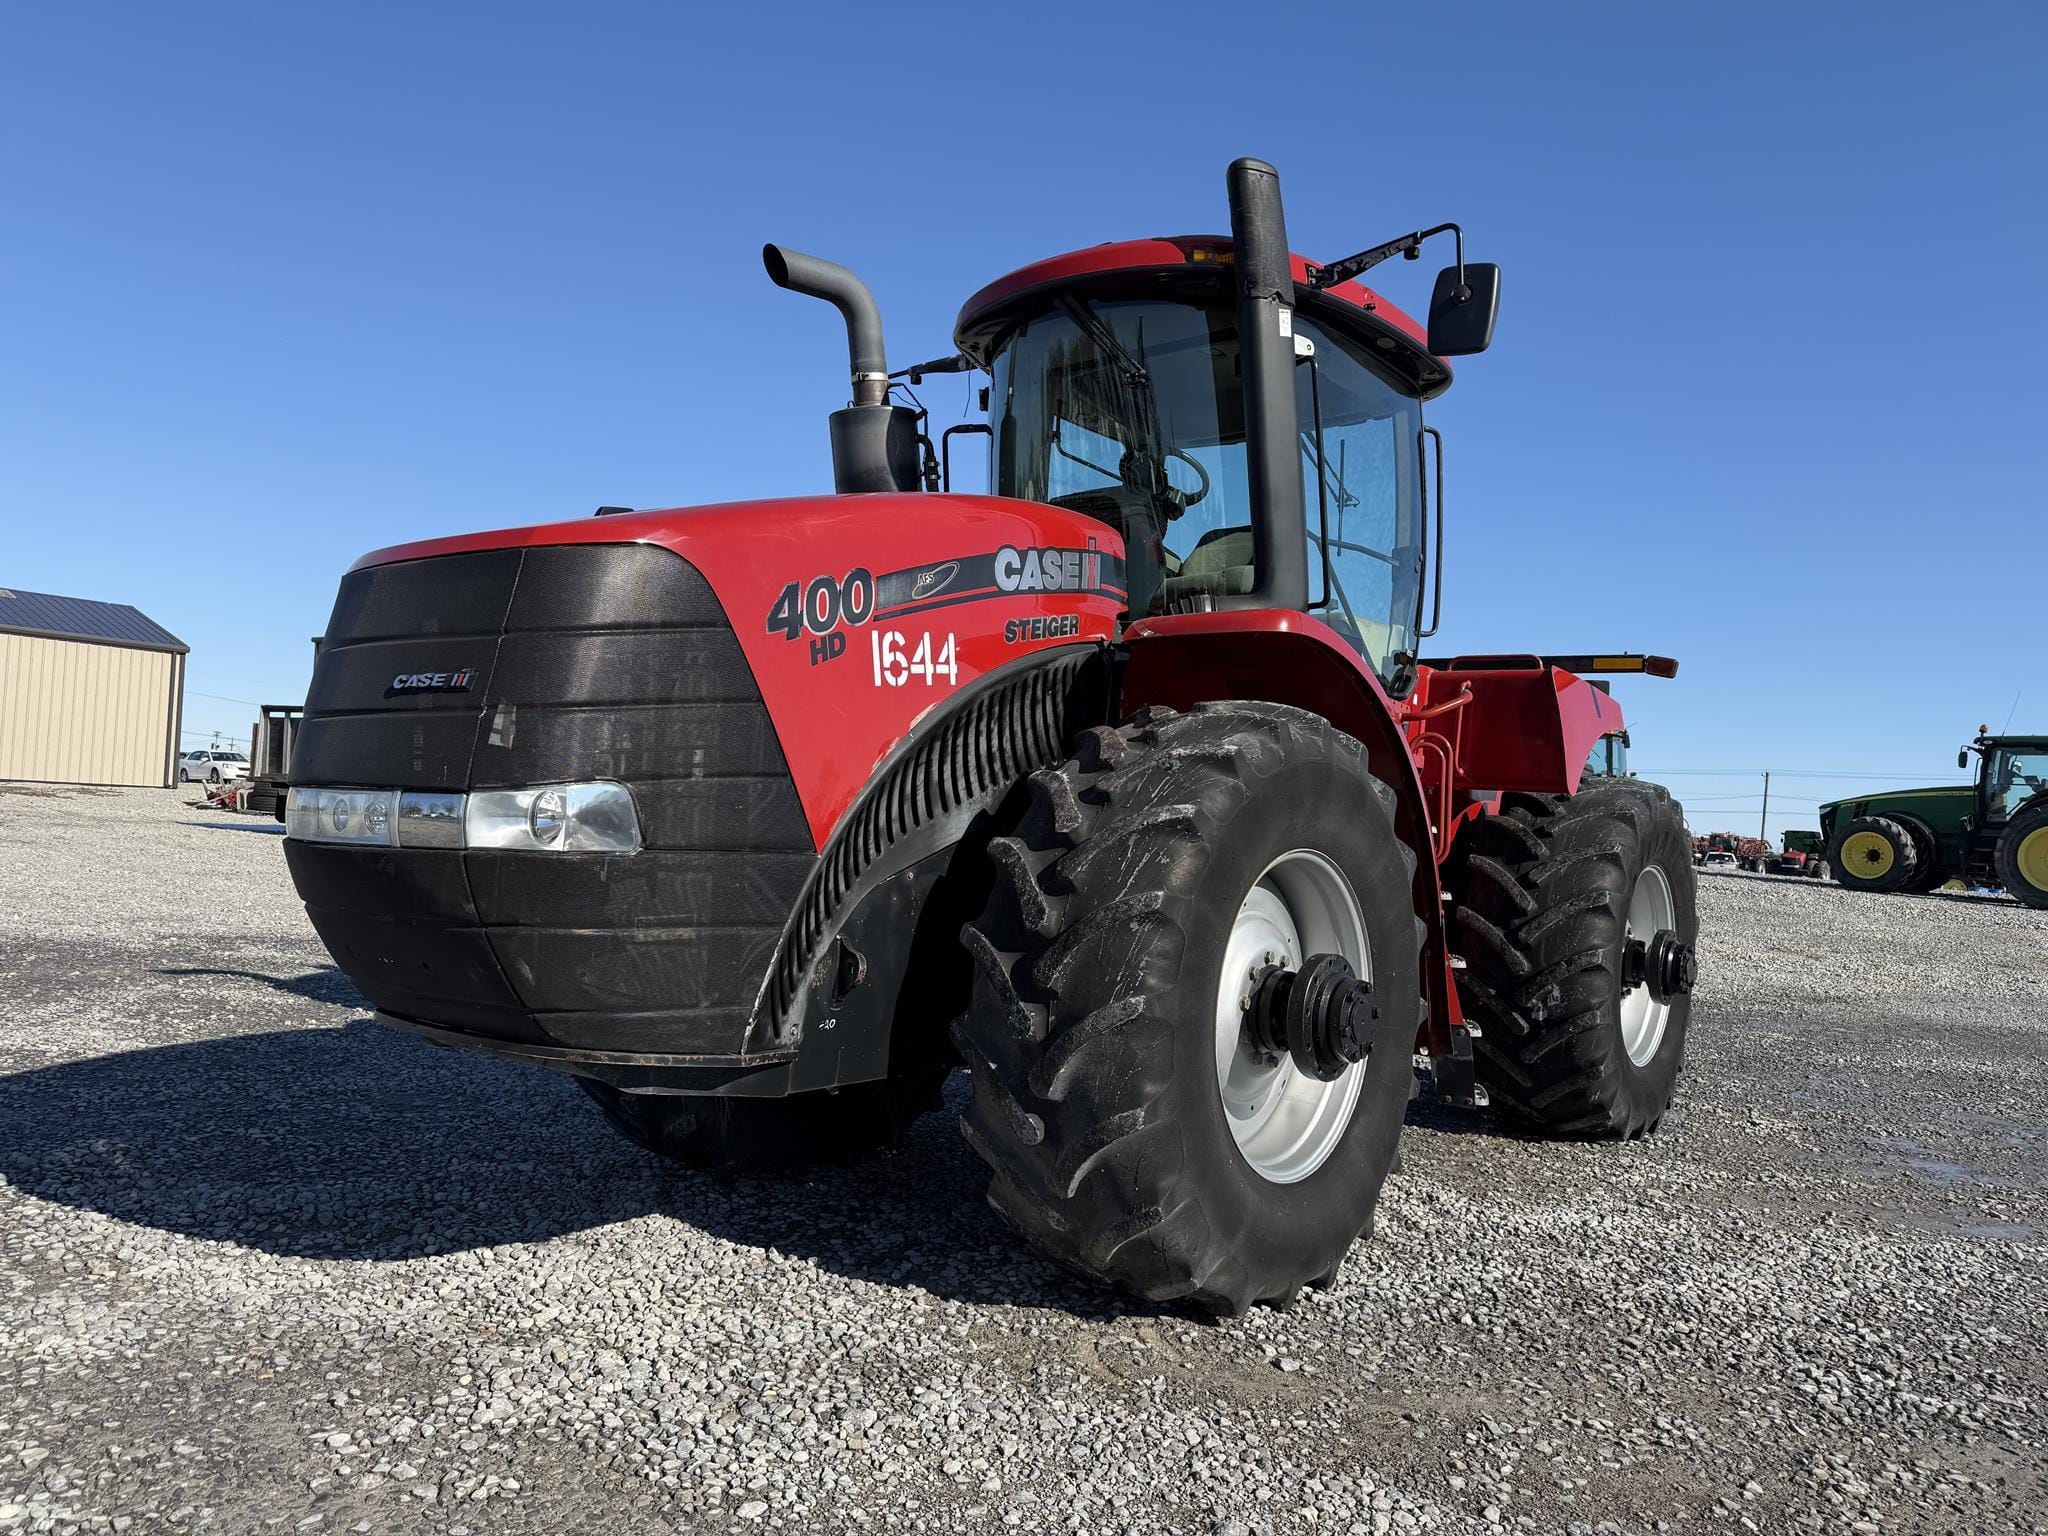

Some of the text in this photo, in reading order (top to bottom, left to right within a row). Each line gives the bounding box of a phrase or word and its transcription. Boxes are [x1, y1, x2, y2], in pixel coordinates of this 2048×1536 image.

[917, 572, 935, 586] AFS
[766, 567, 874, 641] 400
[1004, 614, 1080, 644] STEIGER
[810, 631, 846, 667] HD
[871, 630, 958, 687] 1644
